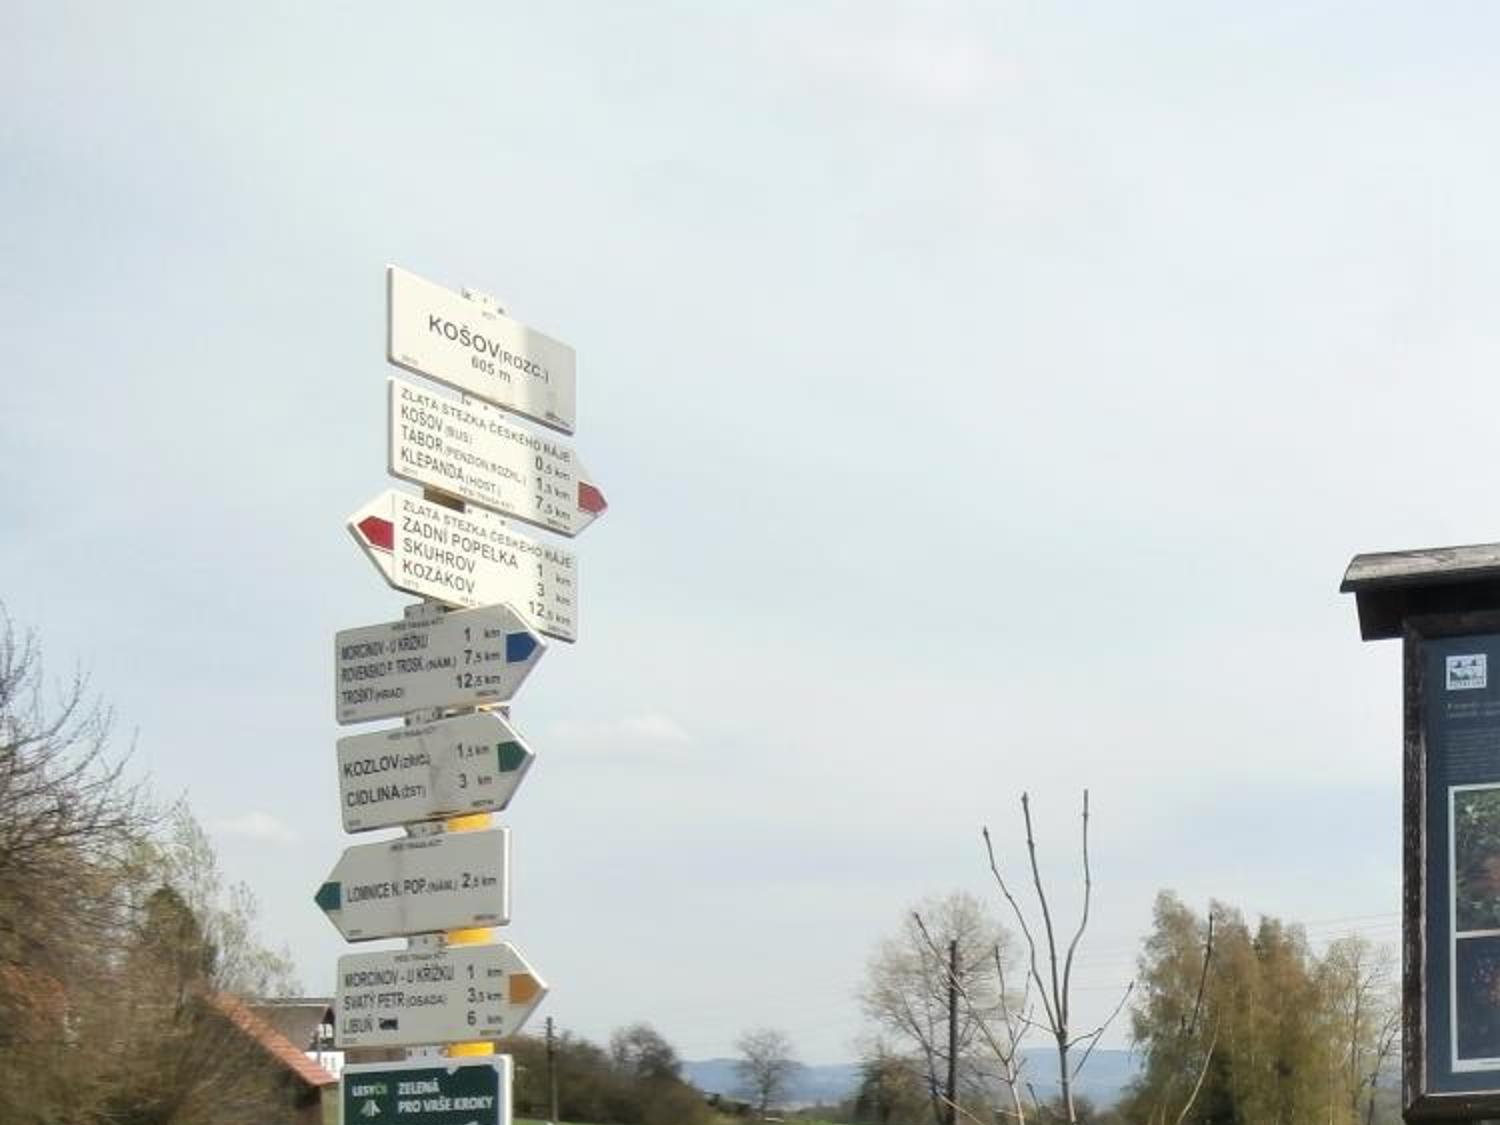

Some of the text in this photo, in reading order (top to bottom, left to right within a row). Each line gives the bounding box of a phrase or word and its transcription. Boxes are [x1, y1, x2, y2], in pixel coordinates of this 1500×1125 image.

[471, 354, 512, 383] 605 m
[442, 403, 486, 432] STEZKA
[401, 403, 443, 432] KOŠOV
[554, 468, 571, 481] km
[401, 446, 464, 482] KLEPANDA
[554, 506, 571, 520] km
[554, 487, 571, 501] km
[444, 514, 487, 538] STEZKA
[452, 533, 518, 569] POPELKA
[537, 563, 543, 577] 1
[554, 573, 571, 587] km
[403, 536, 571, 607] SKUHROV 3 km
[554, 612, 571, 625] km
[464, 627, 471, 642] 1
[484, 628, 501, 639] km
[484, 651, 501, 662] km
[484, 674, 501, 685] km
[344, 754, 399, 777] KOZLOV
[475, 744, 491, 755] km
[347, 784, 400, 808] CIDLINA
[458, 773, 467, 789] 3
[477, 775, 492, 785] km
[481, 877, 497, 886] km
[407, 966, 414, 983] U
[466, 964, 474, 979] 1
[487, 967, 503, 977] km
[378, 991, 405, 1009] PETR
[487, 991, 503, 1001] km
[466, 1010, 476, 1026] 6
[487, 1014, 503, 1025] km
[398, 1078, 440, 1095] ZELENÁ
[398, 1096, 494, 1115] PRO VAŠE KROKY
